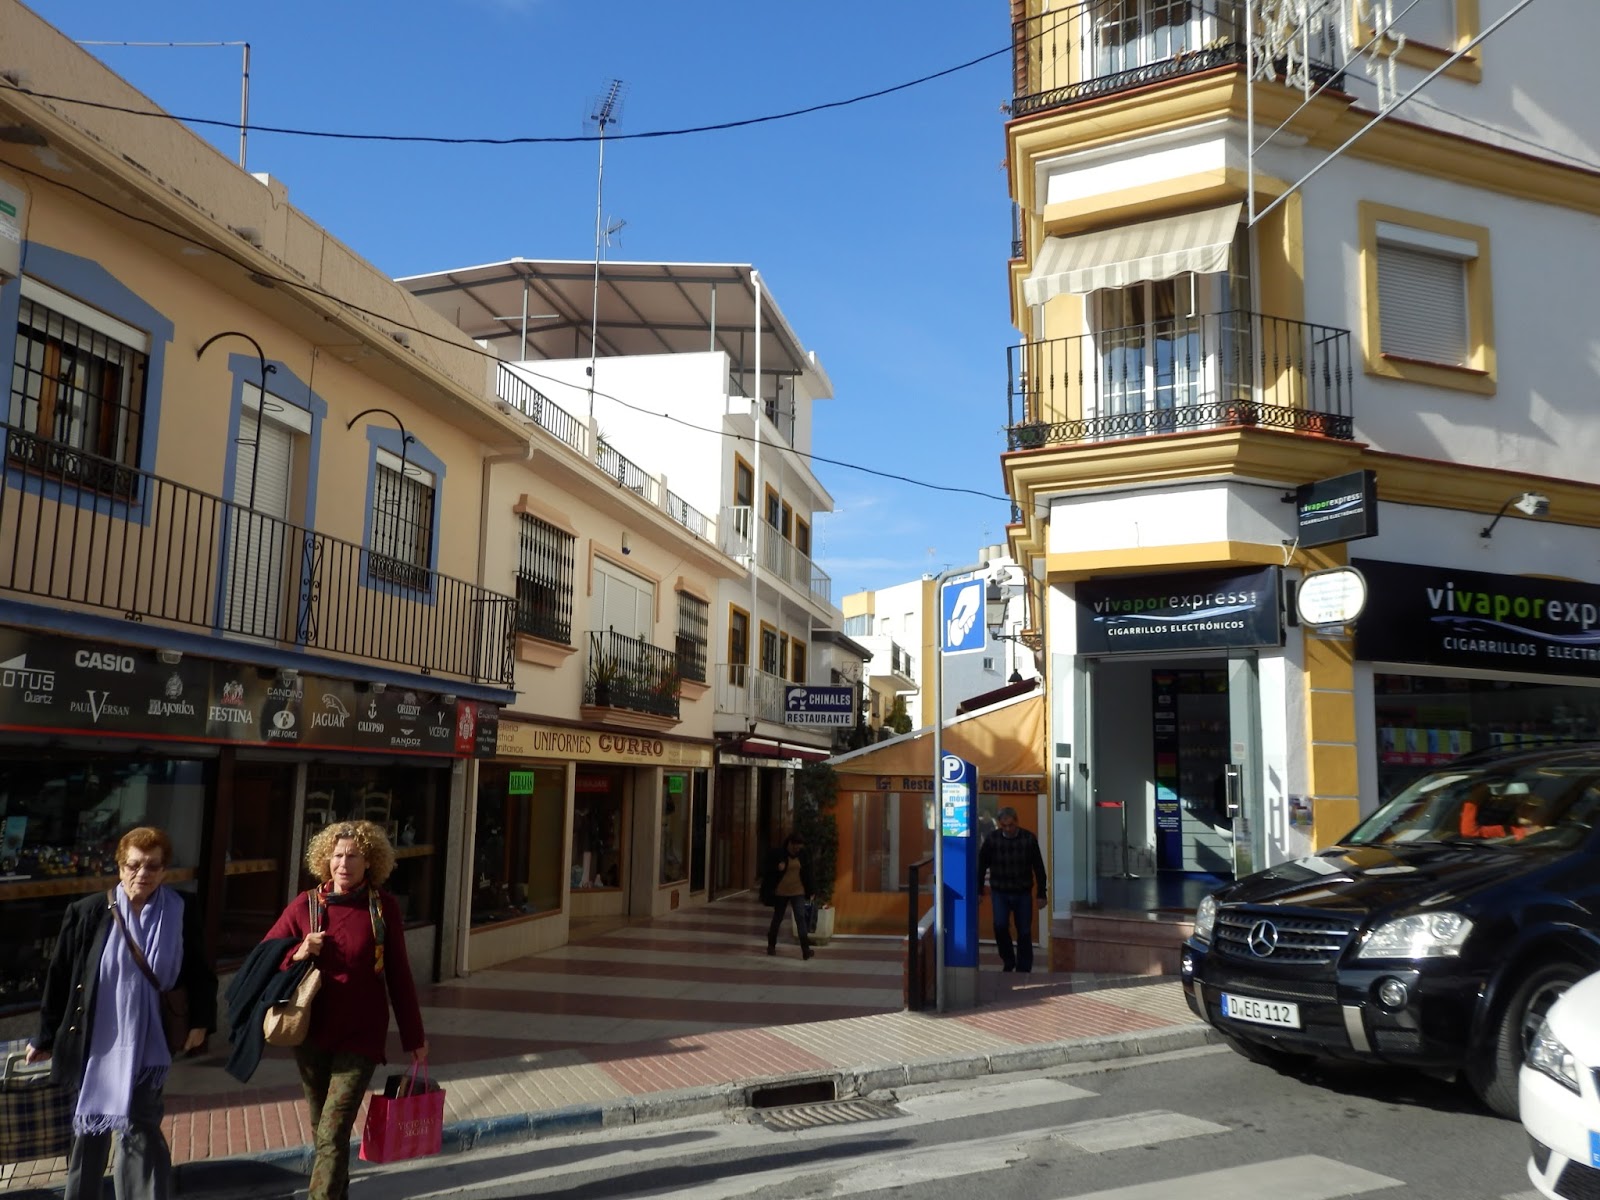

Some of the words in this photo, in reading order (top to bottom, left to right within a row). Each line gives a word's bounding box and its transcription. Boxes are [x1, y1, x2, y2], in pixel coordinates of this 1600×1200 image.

[1093, 590, 1248, 613] vivaporexpress
[1426, 581, 1600, 630] vivaporexp
[1107, 625, 1167, 636] CIGARRILLOS
[1170, 620, 1245, 633] ELECTRÓNICOS
[1442, 636, 1537, 657] CIGARRILLOS
[75, 650, 135, 674] CASIO
[0, 670, 55, 691] OTUS
[24, 691, 52, 704] Quartz
[267, 687, 303, 699] CANDINO
[809, 693, 851, 705] CHINALES
[70, 702, 92, 713] PAUL
[86, 690, 130, 723] VERSAN
[209, 706, 253, 724] FESTINA
[397, 703, 421, 716] ORIENT
[310, 712, 345, 729] JAGUAR
[358, 721, 385, 733] CALYPSO
[787, 713, 850, 724] RESTAURANTE
[267, 729, 280, 738] TIME
[281, 730, 298, 739] FORCE
[390, 736, 421, 746] SANDOZ
[533, 730, 591, 754] UNIFORMES
[598, 734, 664, 757] CURRO
[943, 758, 960, 779] P
[983, 779, 1040, 793] CHINALES
[1264, 1004, 1291, 1023] 112
